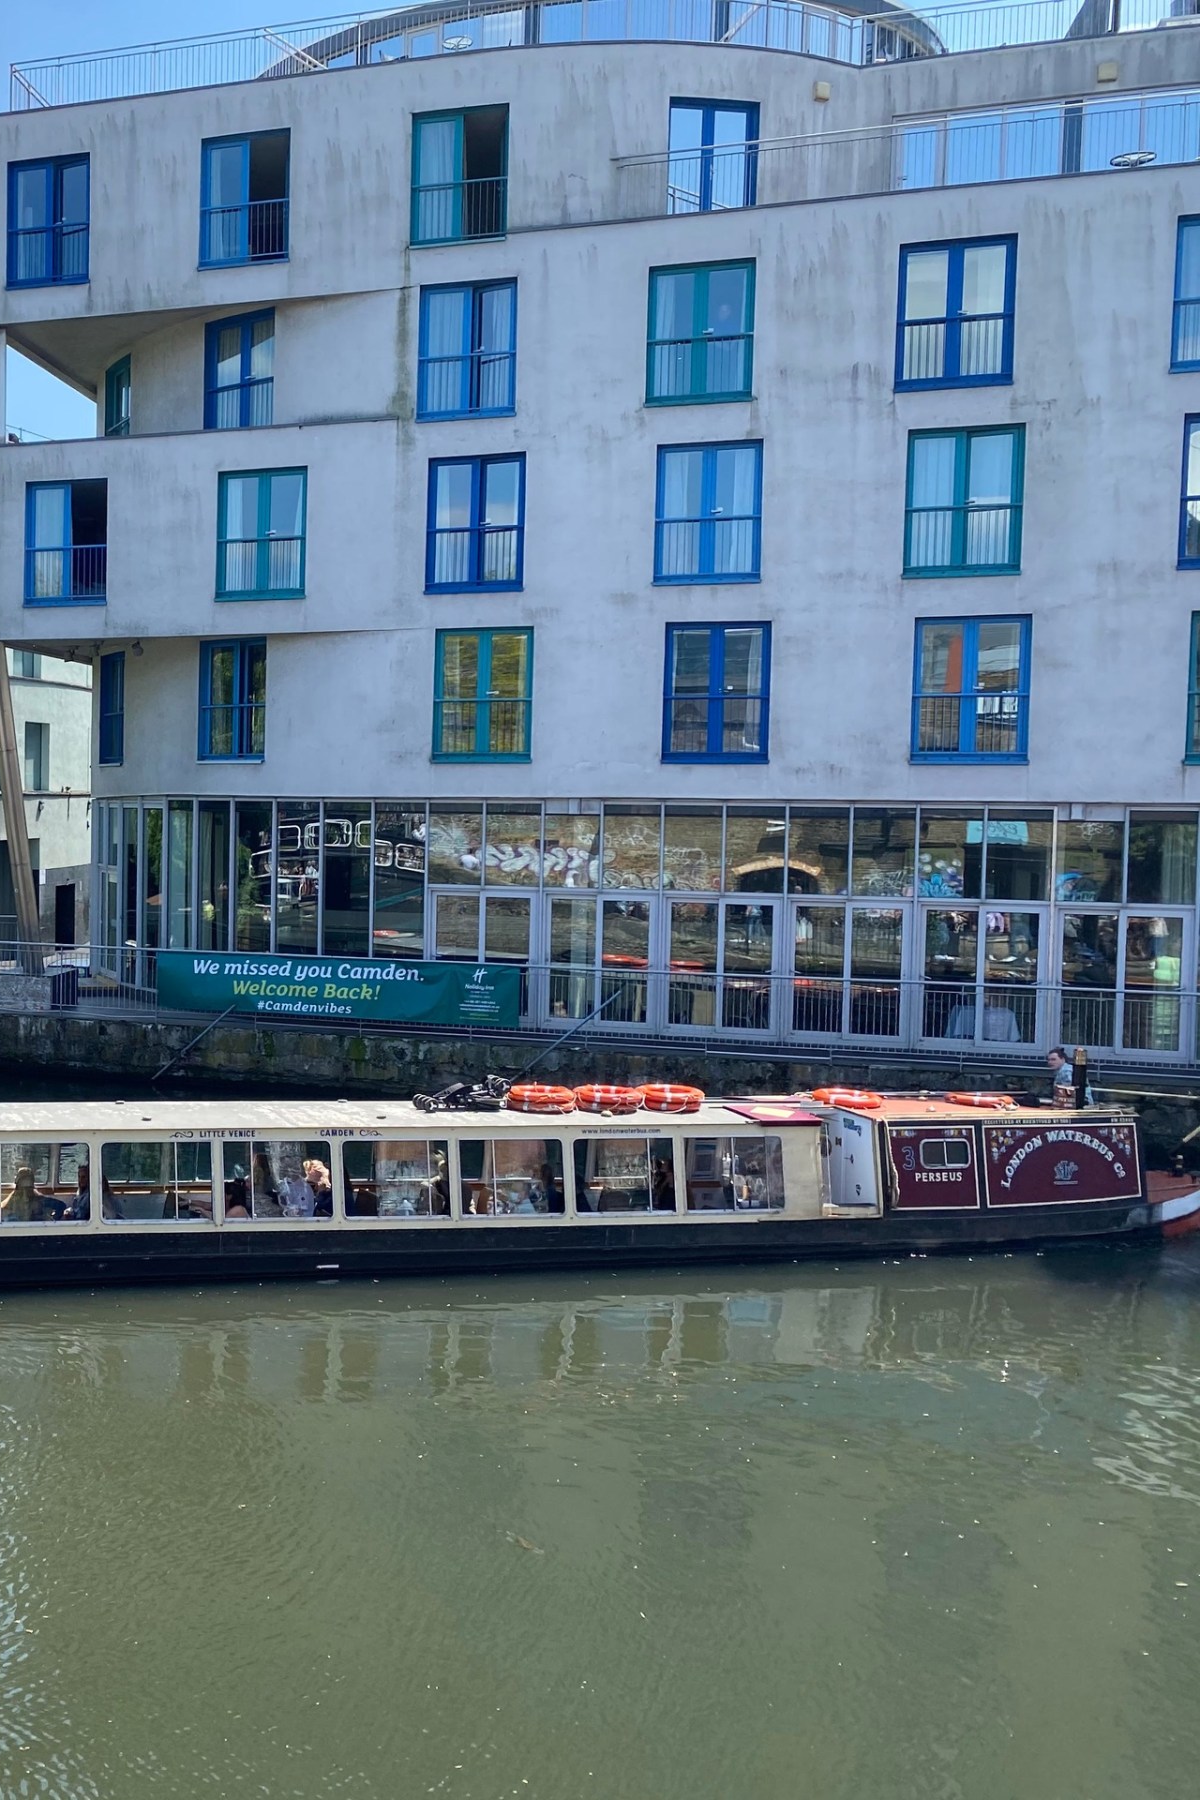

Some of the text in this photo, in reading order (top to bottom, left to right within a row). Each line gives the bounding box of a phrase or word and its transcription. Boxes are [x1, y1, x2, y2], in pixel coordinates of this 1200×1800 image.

[193, 959, 425, 981] We missed you Camden.
[233, 980, 381, 1000] Welcome Back!
[257, 1000, 353, 1014] #Camdenvibes
[200, 1130, 256, 1138] LITTLE VENICE
[319, 1129, 354, 1137] CAMDEN
[902, 1146, 916, 1171] 3
[1001, 1135, 1043, 1190] LONDON
[1045, 1129, 1115, 1161] WATERBUS
[915, 1172, 963, 1182] PERSEUS
